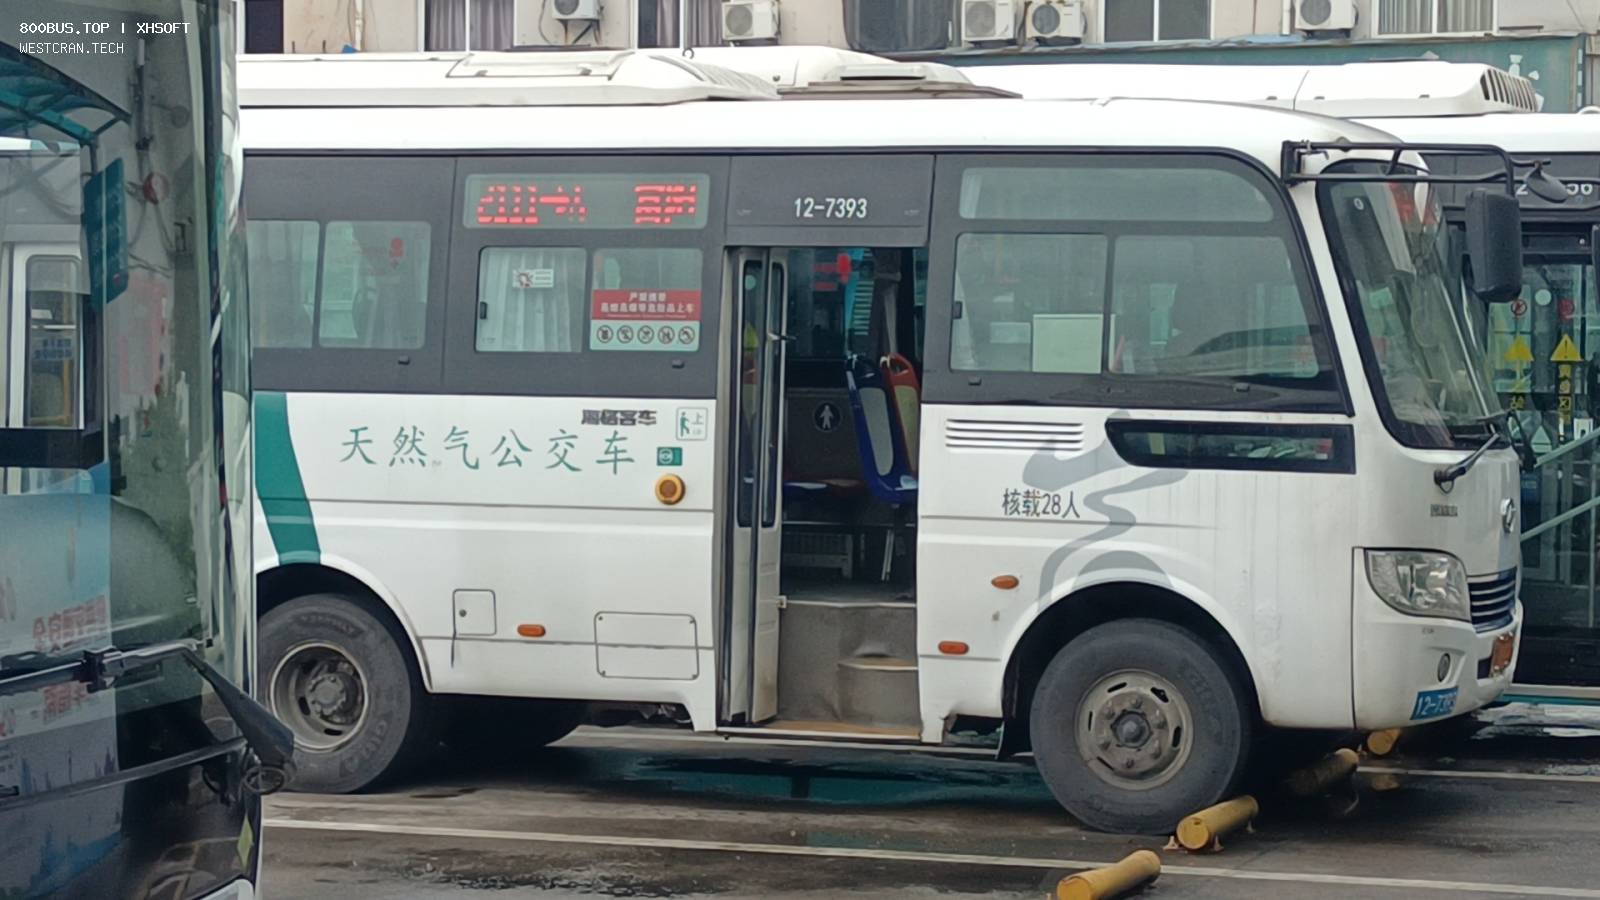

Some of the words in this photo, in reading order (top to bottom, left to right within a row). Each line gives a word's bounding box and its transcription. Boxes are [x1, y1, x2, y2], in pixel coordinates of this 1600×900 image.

[794, 197, 868, 219] 12-7393
[340, 424, 636, 475] 天然气公交车
[1002, 487, 1080, 518] 核载28人
